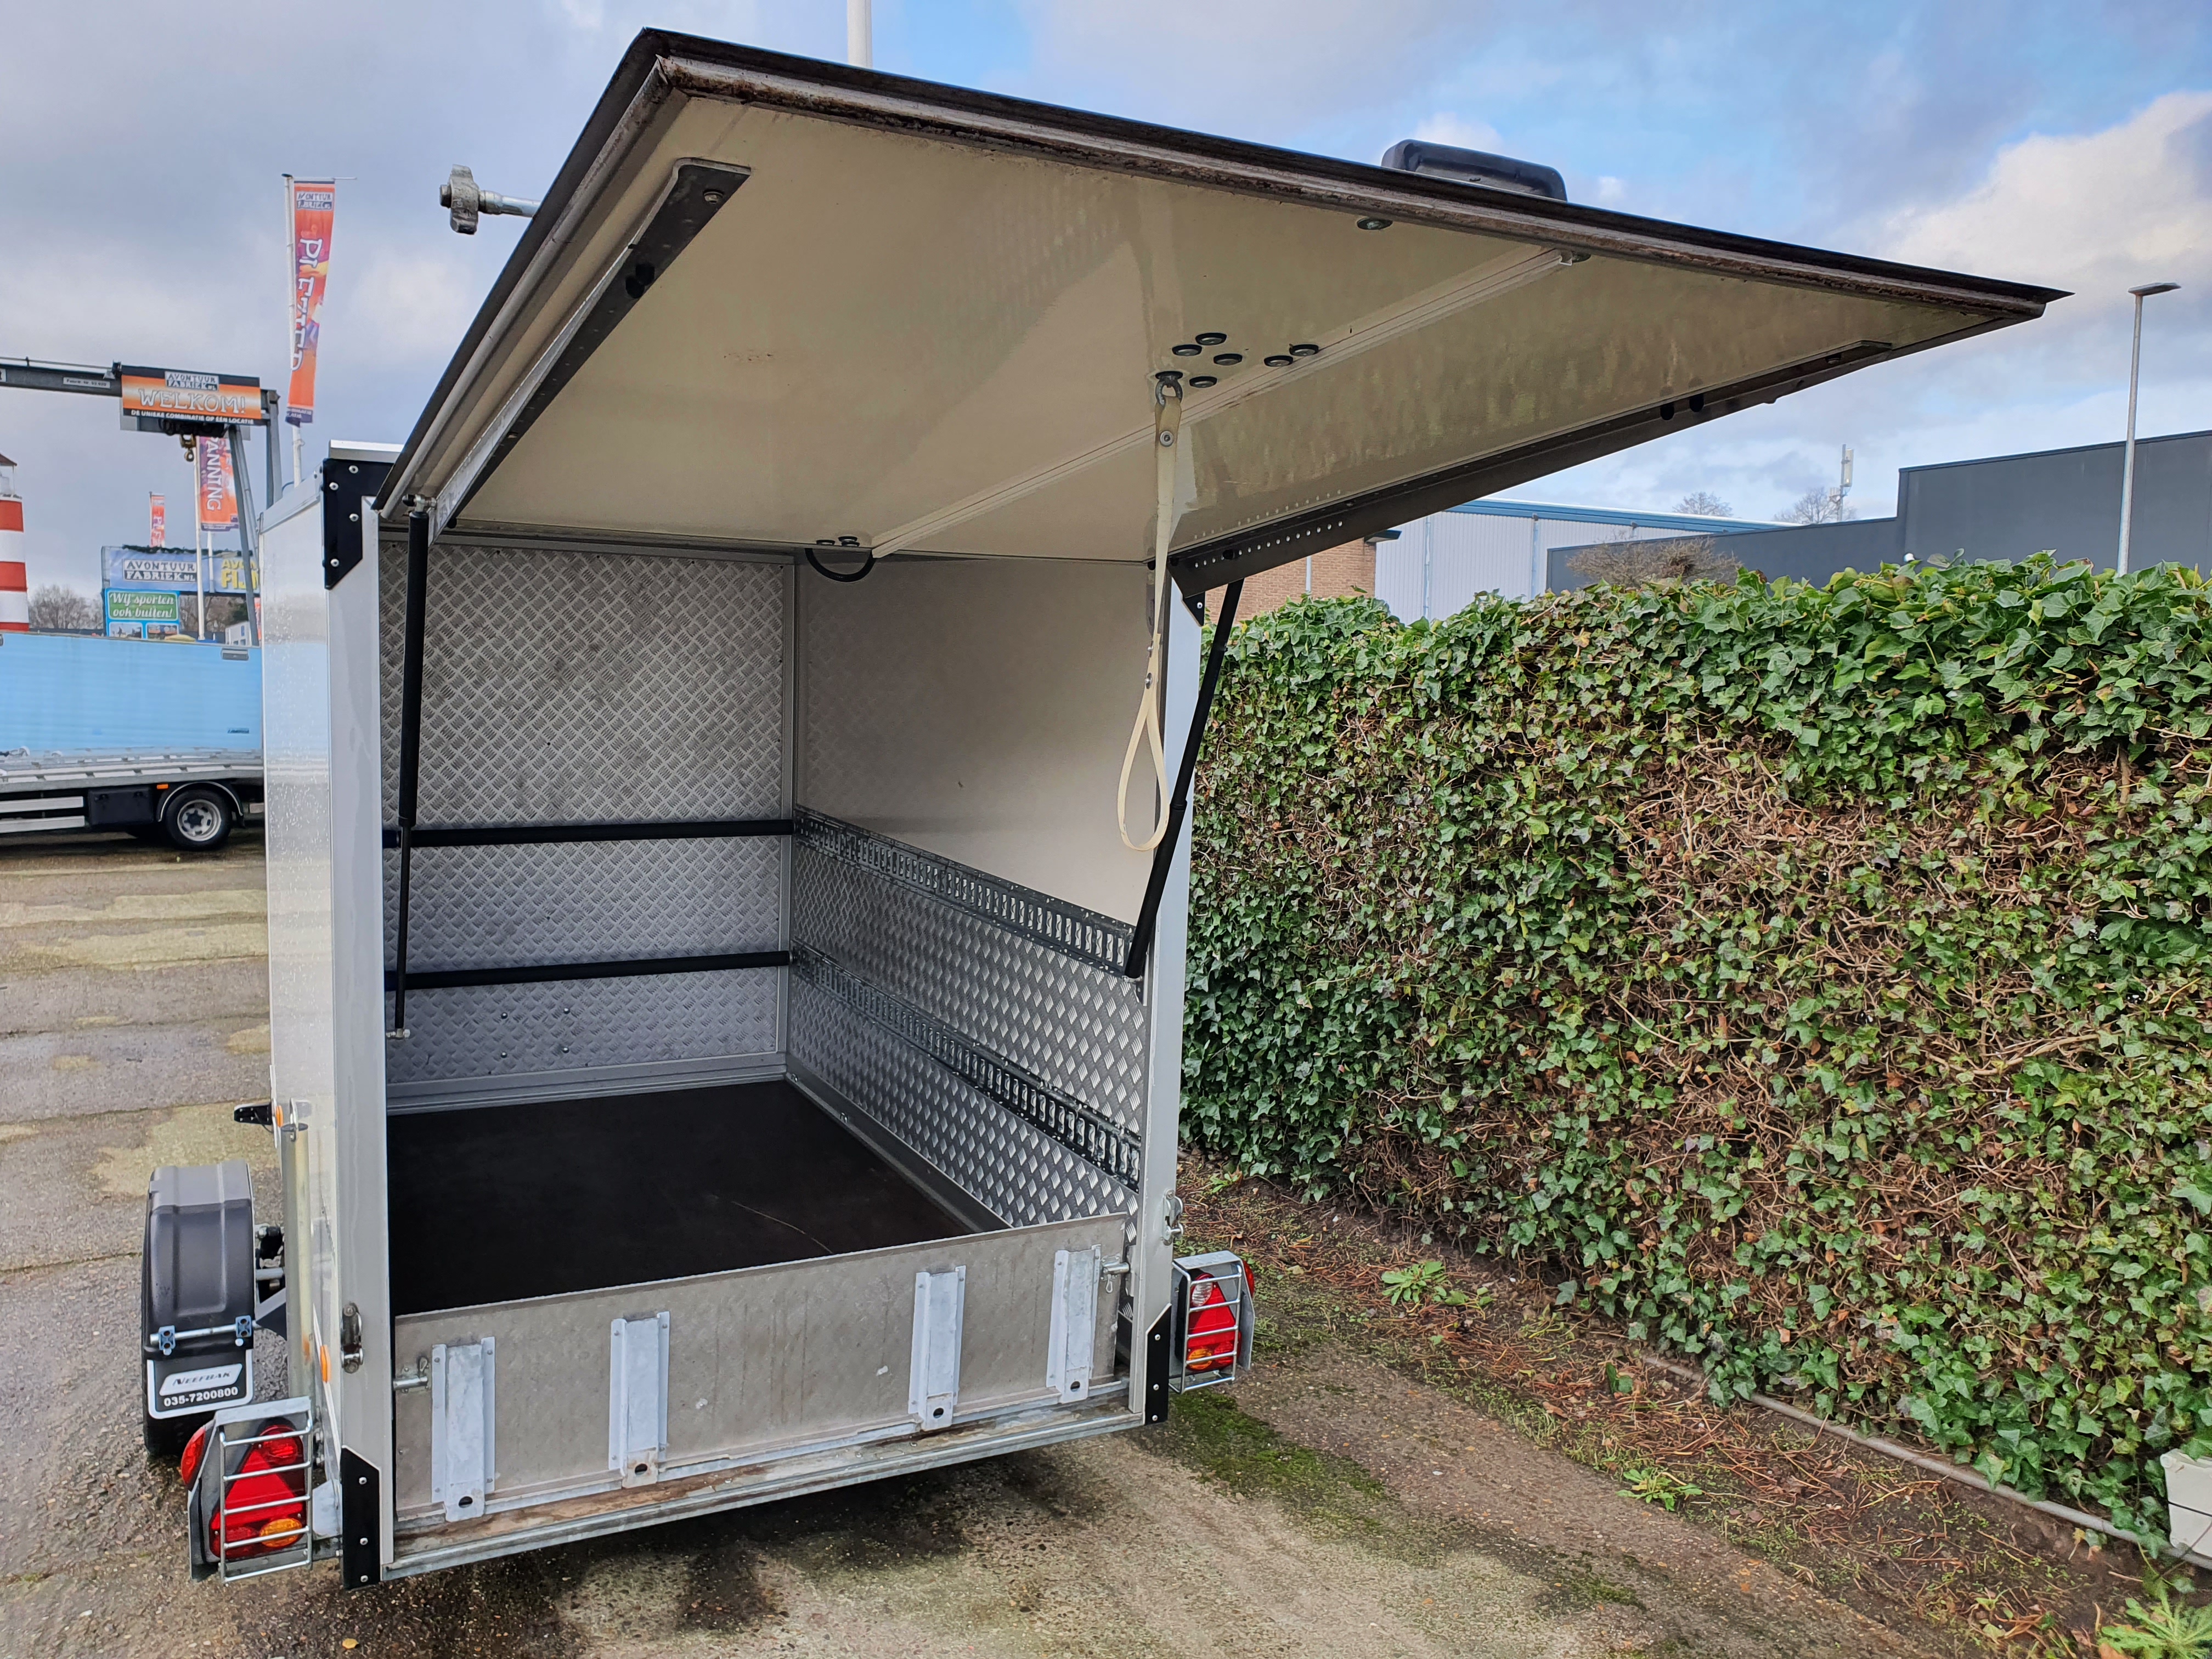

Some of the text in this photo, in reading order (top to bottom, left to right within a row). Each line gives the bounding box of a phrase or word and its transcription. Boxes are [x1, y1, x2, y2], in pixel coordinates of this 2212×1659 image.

[168, 373, 216, 383] AVONTUUR
[138, 388, 246, 414] WELKOM!
[166, 413, 205, 421] COMBINATIE
[127, 561, 195, 571] AVONTUUR
[134, 595, 174, 607] sporten
[113, 607, 132, 617] ook
[164, 1386, 238, 1407] 035-7200800
